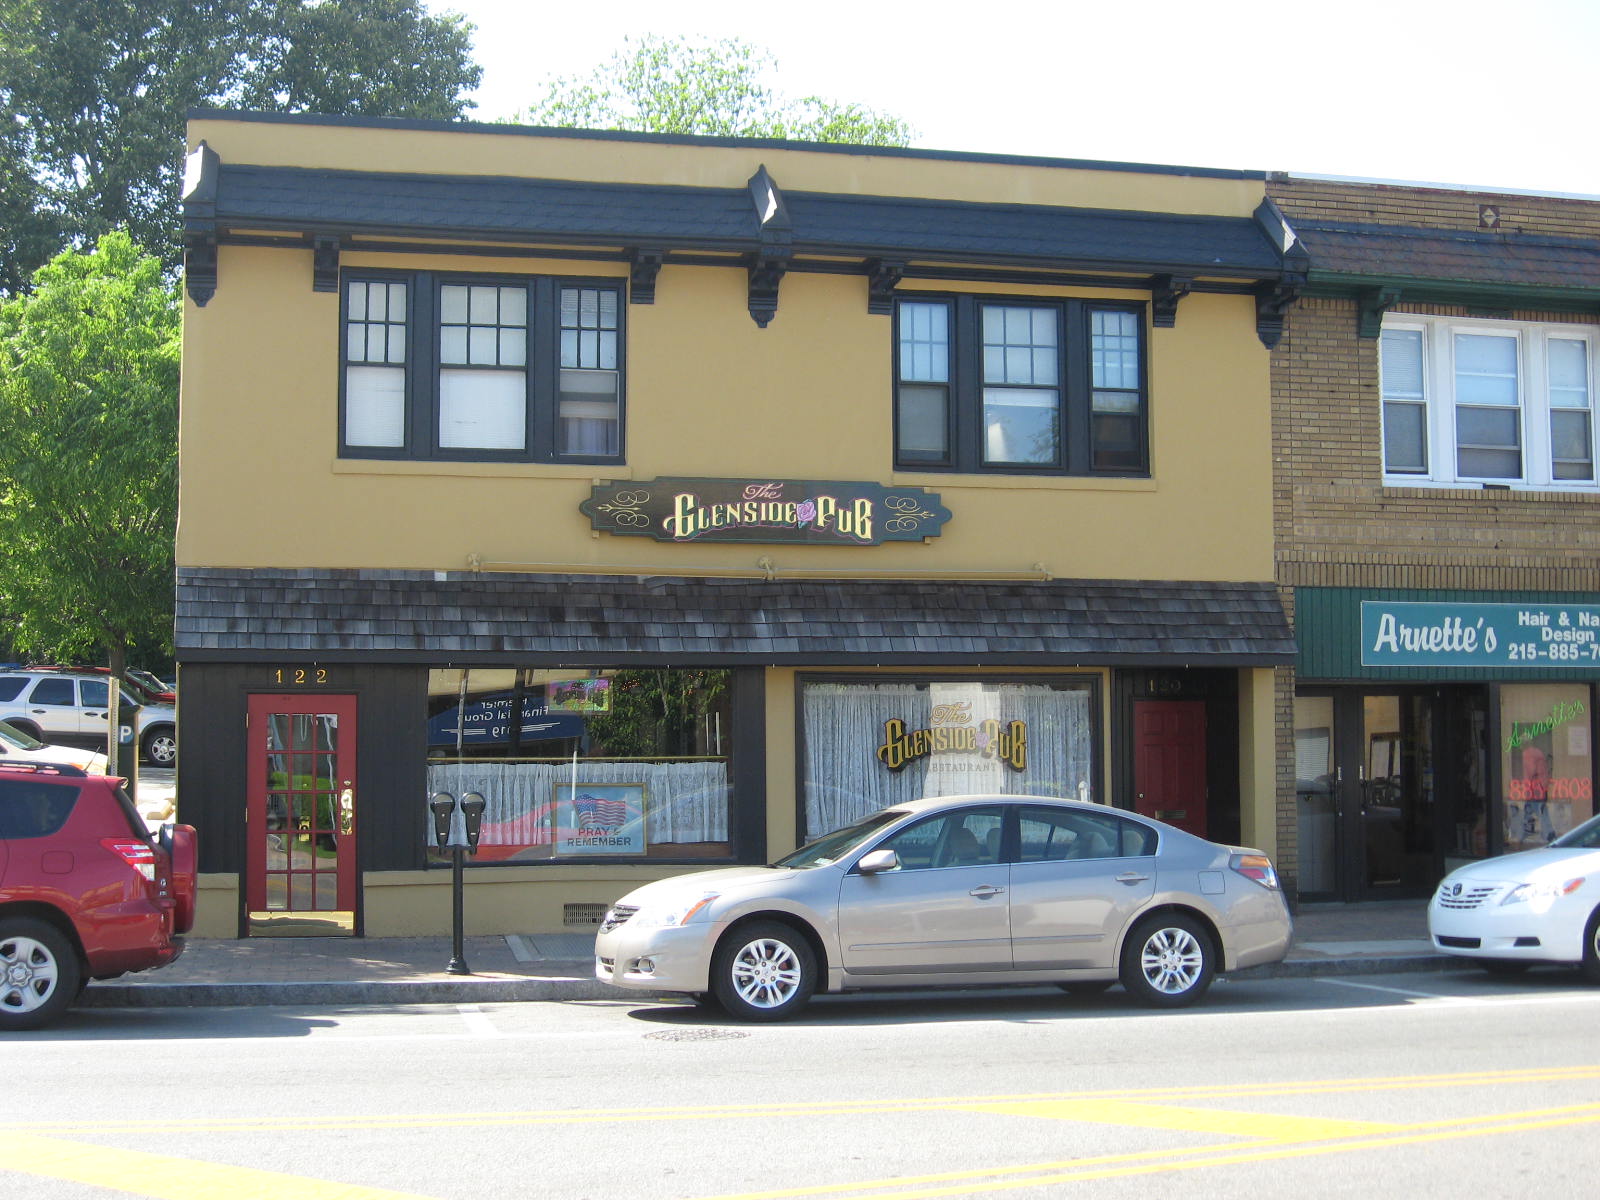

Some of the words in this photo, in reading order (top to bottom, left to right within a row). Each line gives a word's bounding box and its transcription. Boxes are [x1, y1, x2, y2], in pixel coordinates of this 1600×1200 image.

[743, 483, 784, 500] The
[1518, 611, 1550, 626] Hair
[1558, 611, 1570, 626] &
[1373, 613, 1497, 653] Arnette's
[1541, 627, 1595, 644] Design
[1508, 643, 1600, 660] 215-885-7
[275, 669, 327, 683] 122
[931, 702, 972, 725] The
[120, 726, 132, 742] P
[578, 828, 610, 836] PRAY
[567, 837, 631, 847] REMEMBER
